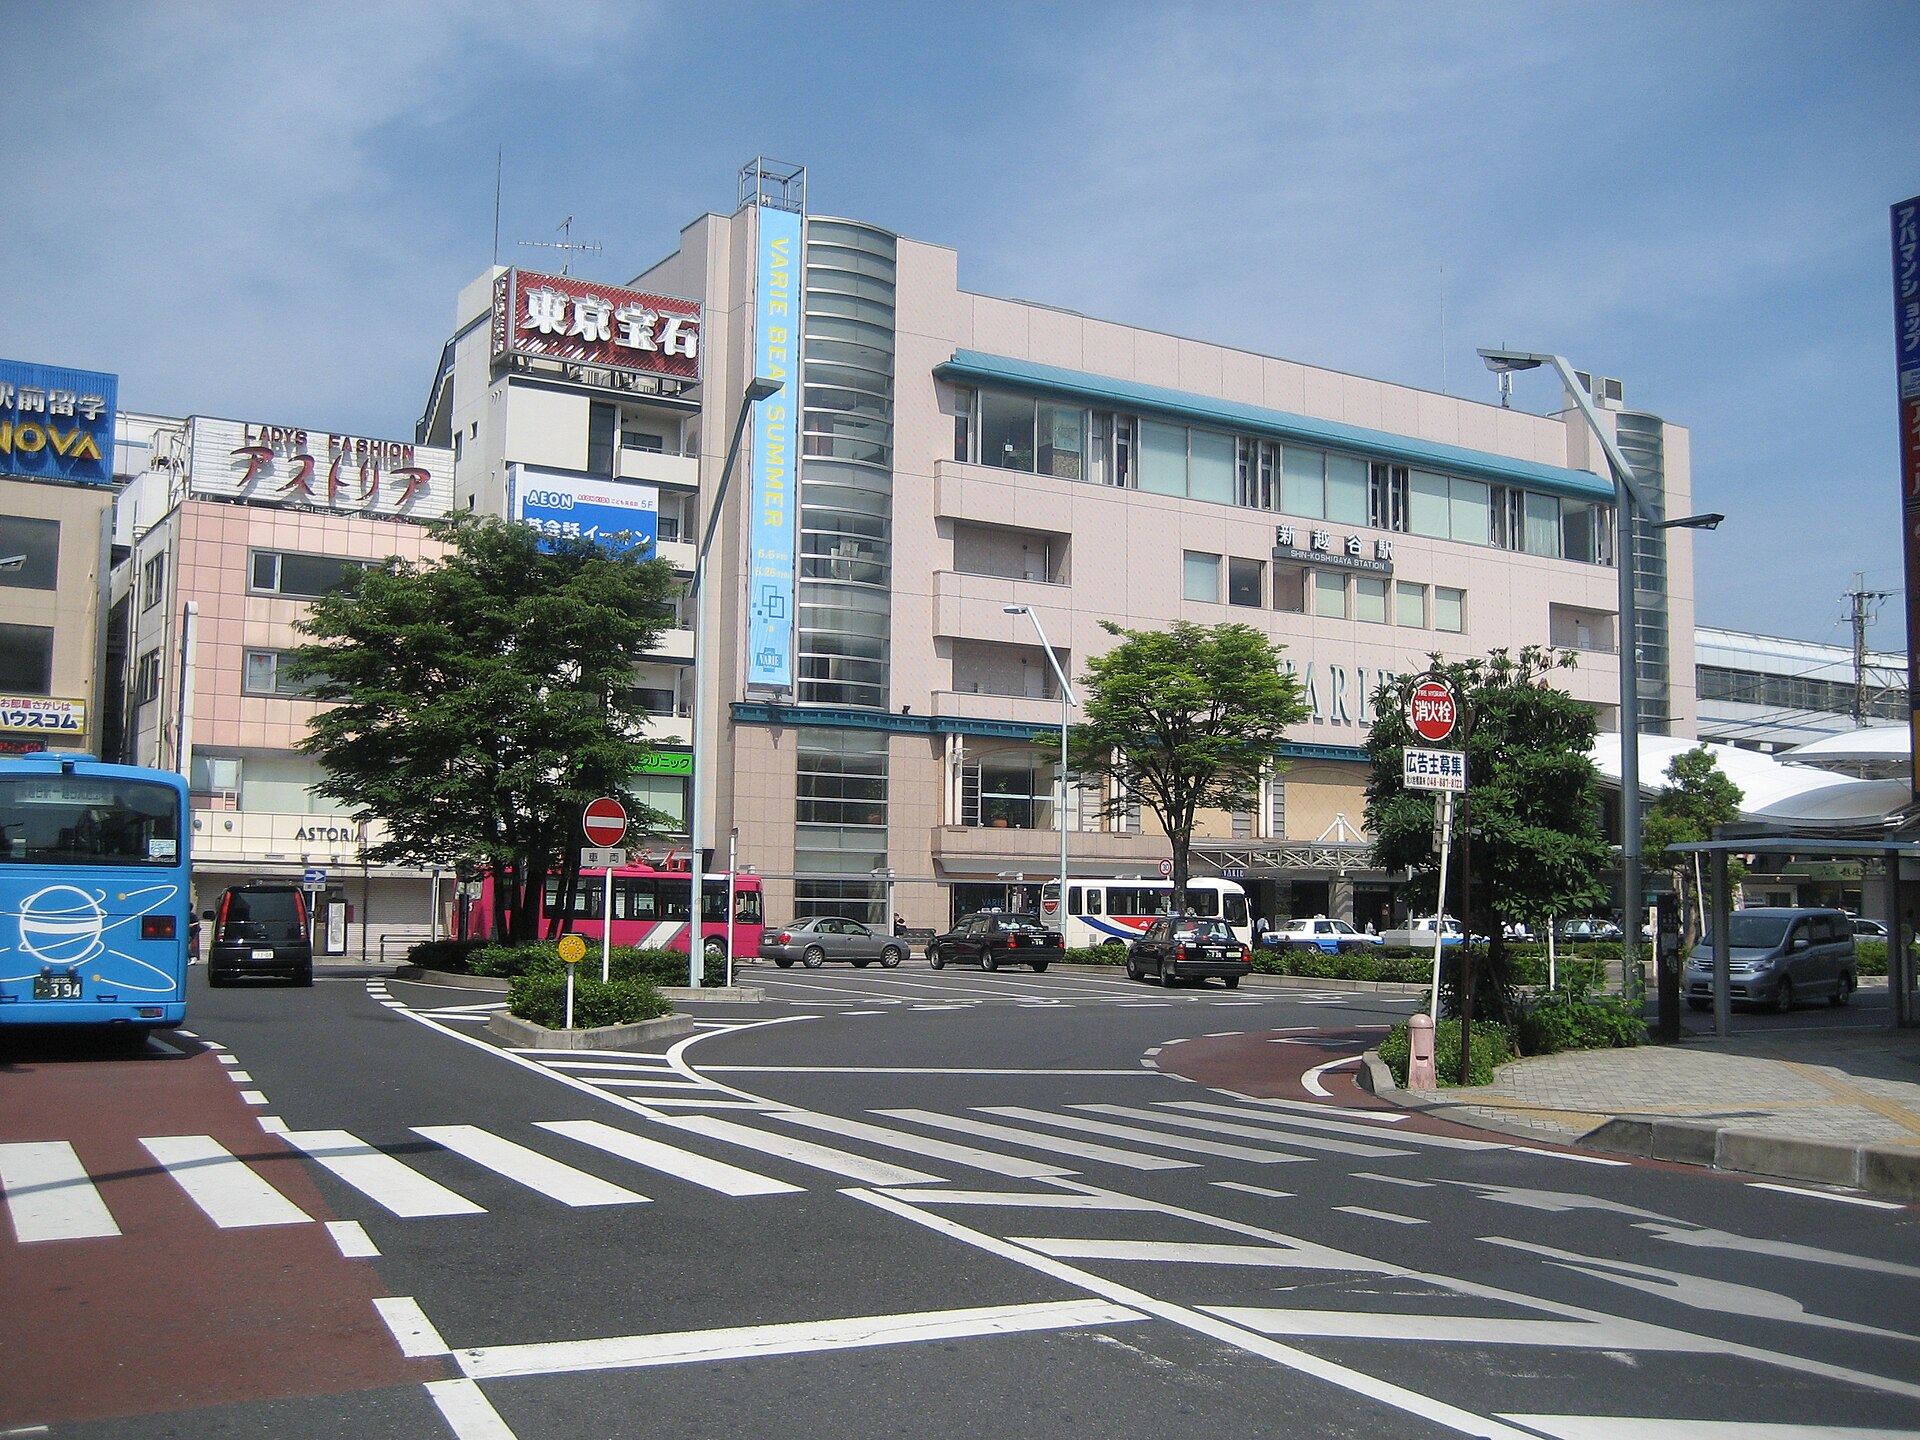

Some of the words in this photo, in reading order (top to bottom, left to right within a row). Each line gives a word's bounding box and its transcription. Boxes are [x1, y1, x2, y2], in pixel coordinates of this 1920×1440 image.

[769, 238, 789, 317] VARIE
[1898, 206, 1920, 352] アパマンショップ
[520, 285, 700, 359] 東京宝石
[768, 326, 788, 399] BEA
[328, 435, 415, 460] FASHION
[230, 446, 431, 506] アストリア
[764, 405, 786, 527] SUMMER
[527, 489, 572, 507] AEON
[641, 500, 653, 508] 5F
[1278, 523, 1393, 560] 新越谷駅
[1290, 549, 1352, 566] SHIN-KOSHIGAYA
[1354, 558, 1385, 570] STATION
[1277, 659, 1397, 723] ARI
[1417, 689, 1428, 697] FIRE
[0, 699, 71, 711] お部屋さがしは
[1415, 700, 1452, 723] 消火栓
[640, 755, 690, 769] クリニック
[1406, 752, 1462, 776] 広告主募集
[295, 826, 367, 843] ASTORIA
[588, 852, 619, 864] 車両
[1161, 863, 1170, 872] 30
[982, 898, 1005, 907] VARIE
